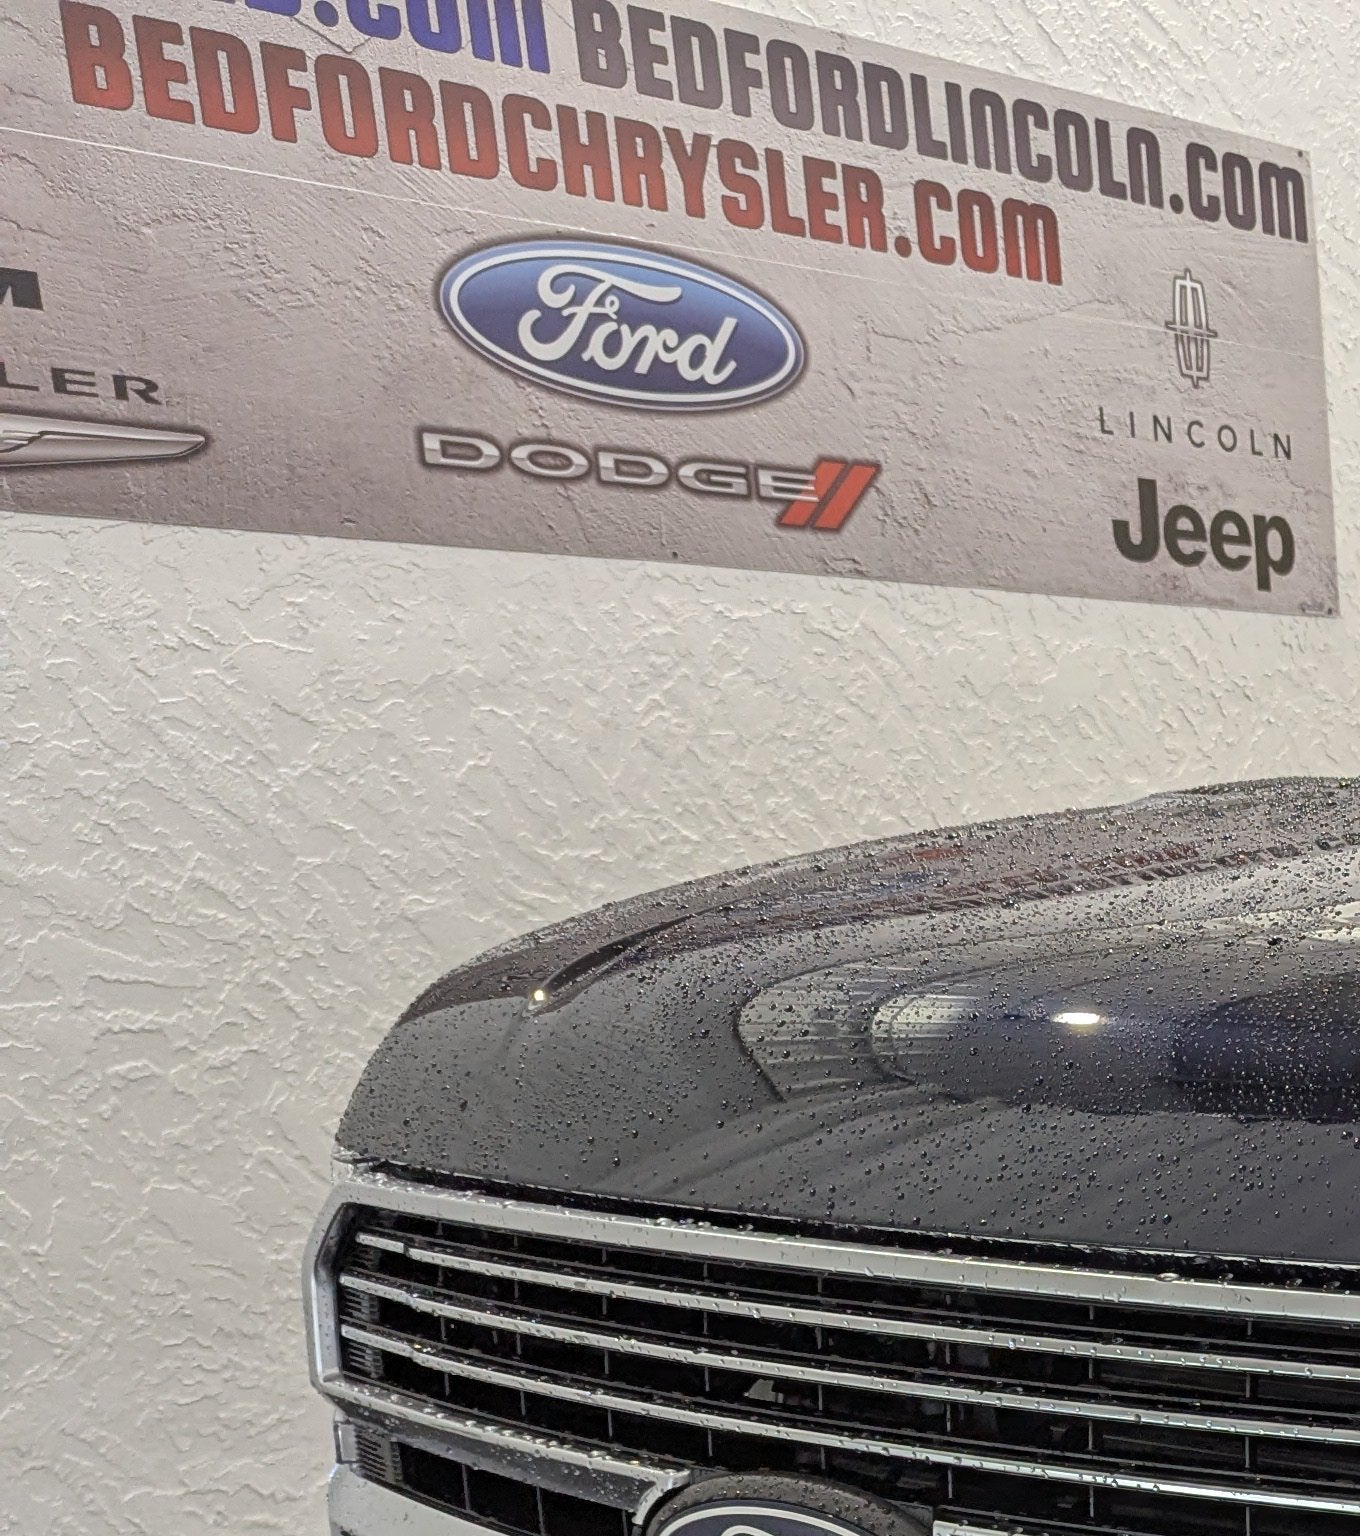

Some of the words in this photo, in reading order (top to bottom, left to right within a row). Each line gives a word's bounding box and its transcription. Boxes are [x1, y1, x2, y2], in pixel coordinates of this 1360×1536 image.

[60, 0, 1063, 286] BEDFORDCHRYSLER.COM
[573, 0, 1309, 243] BEDFORDLINCOLN.COM
[518, 263, 738, 385] Ford
[421, 431, 820, 503] DODGE
[1099, 406, 1292, 460] LINCOLN
[1111, 477, 1296, 592] Jeep
